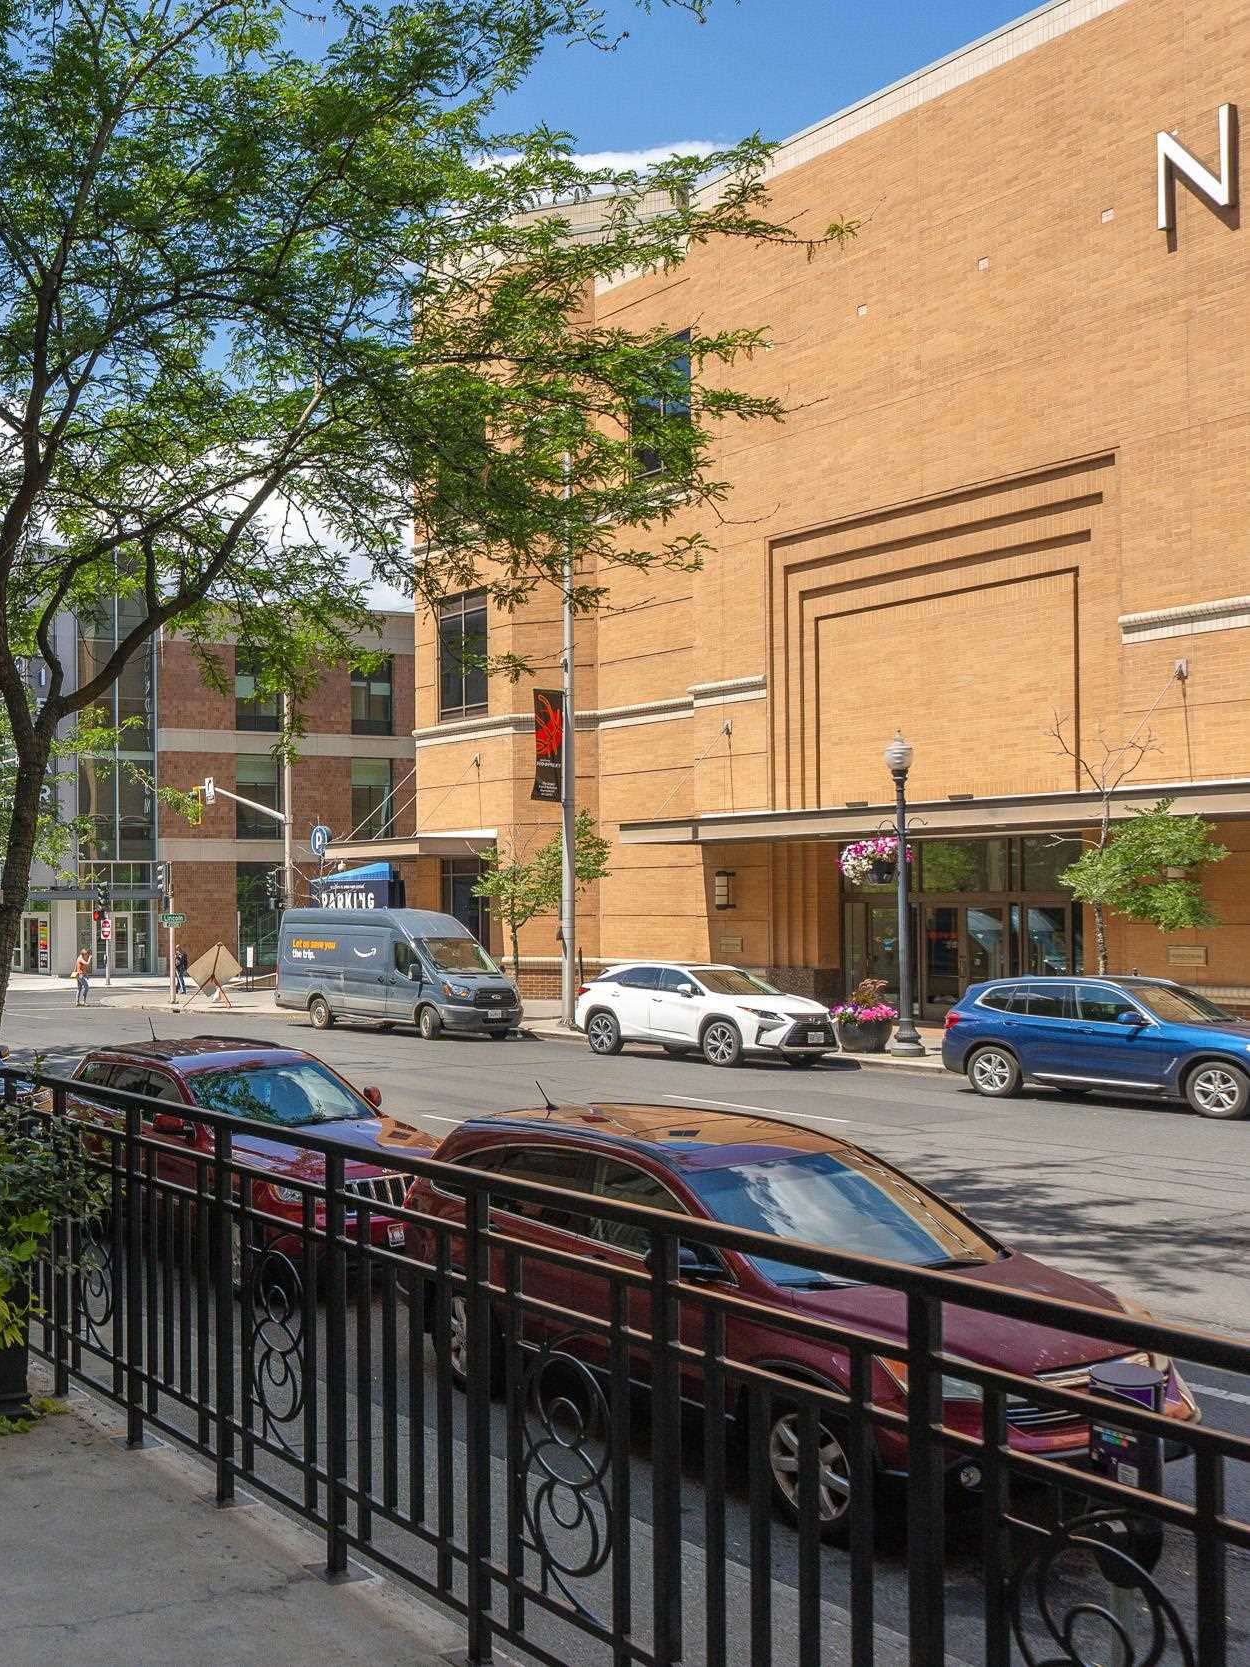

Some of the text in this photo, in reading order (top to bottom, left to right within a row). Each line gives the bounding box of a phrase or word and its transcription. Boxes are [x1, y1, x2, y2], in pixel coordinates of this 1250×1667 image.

[1157, 103, 1235, 232] N
[315, 832, 323, 850] P
[321, 892, 375, 909] PARKING
[292, 938, 302, 949] Let
[324, 941, 336, 951] you
[292, 949, 315, 960] the trip.
